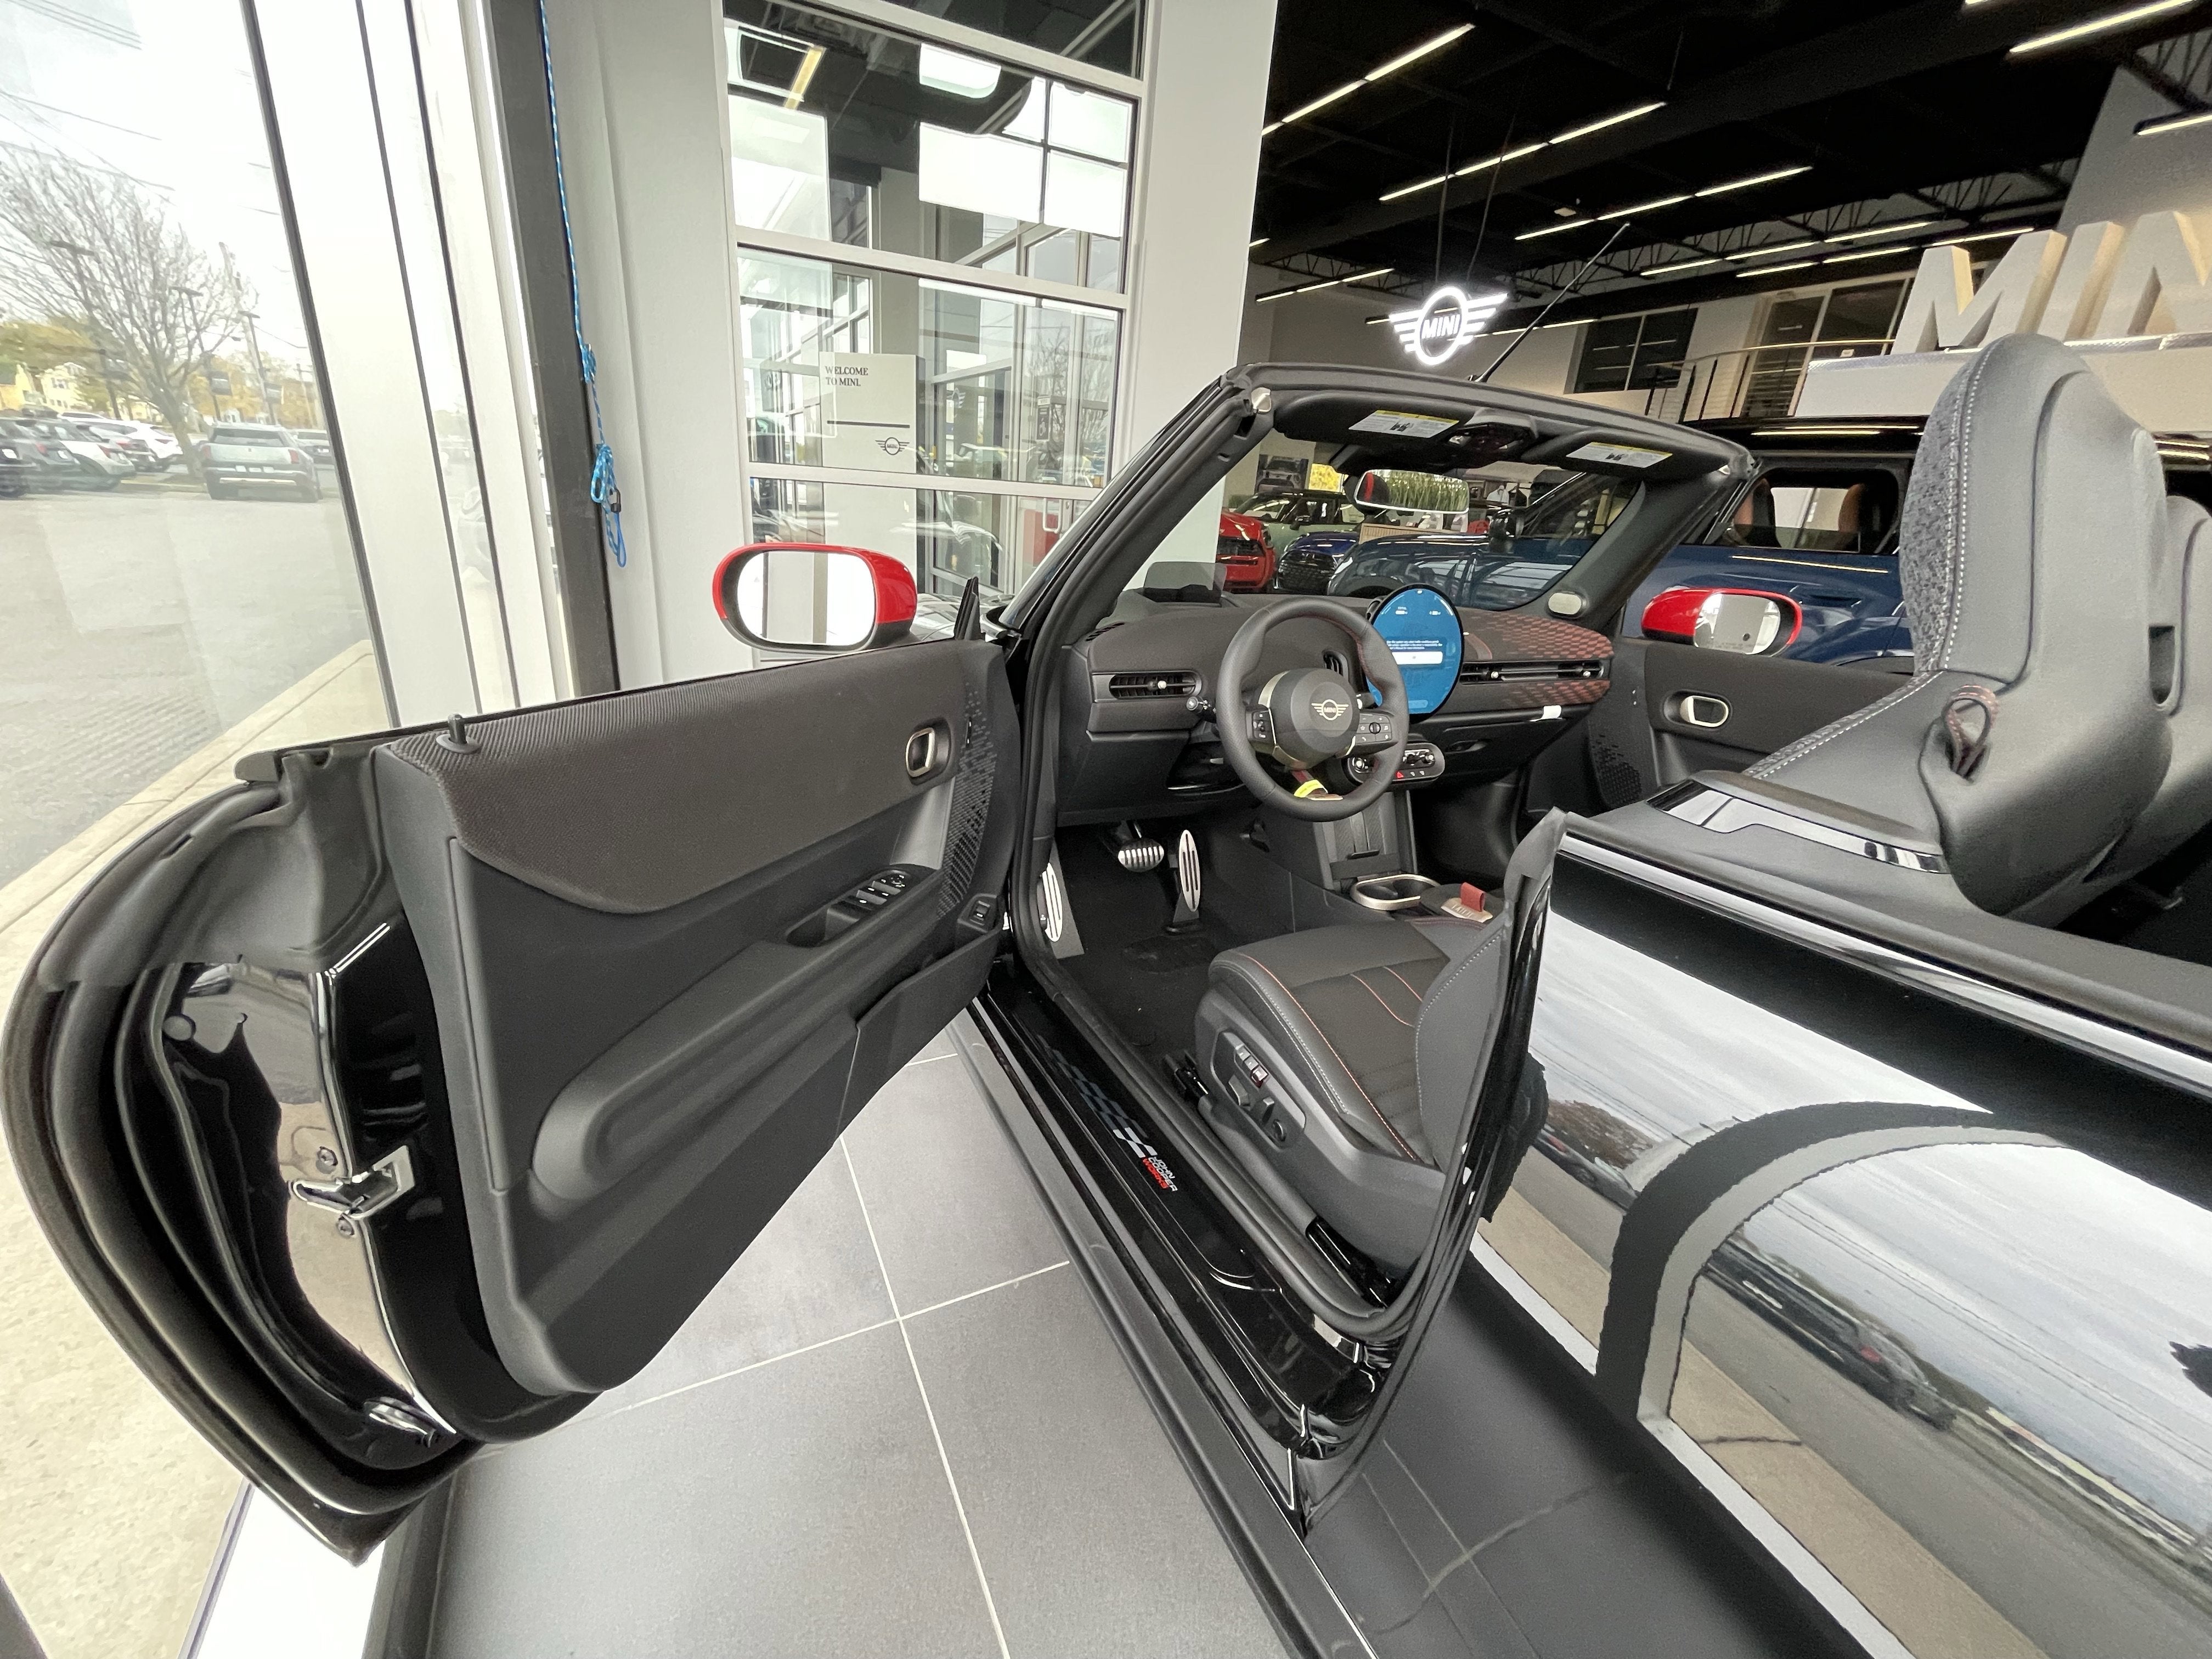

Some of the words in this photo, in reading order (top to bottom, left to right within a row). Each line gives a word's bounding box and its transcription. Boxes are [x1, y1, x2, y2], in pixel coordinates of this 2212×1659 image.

[1421, 314, 1460, 339] MINI
[825, 366, 868, 376] WELCOME
[826, 377, 837, 385] TO
[1143, 1158, 1169, 1188] WORKS
[1148, 1157, 1178, 1192] COOPER
[1153, 1156, 1175, 1179] JOHN
